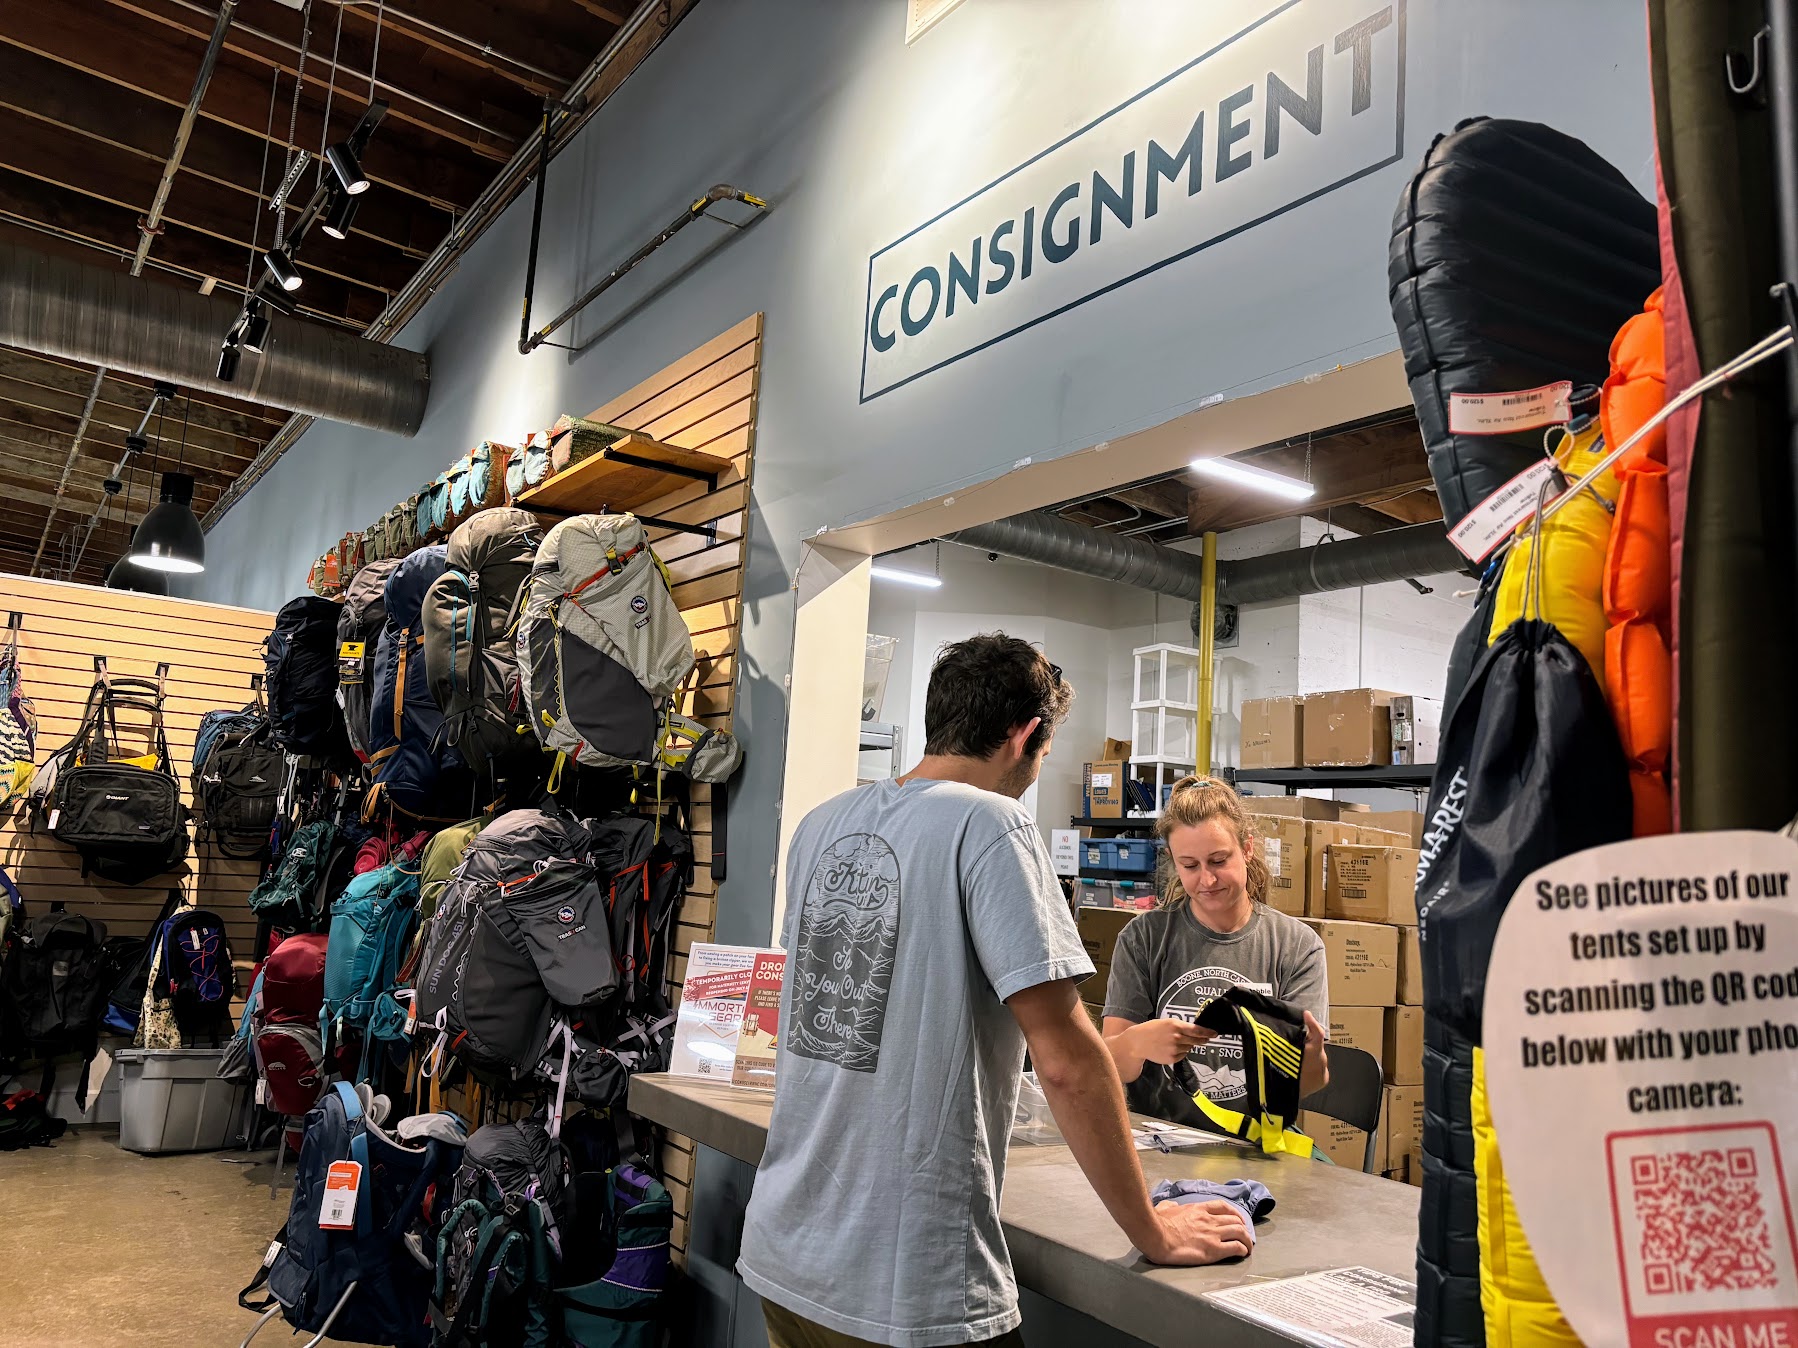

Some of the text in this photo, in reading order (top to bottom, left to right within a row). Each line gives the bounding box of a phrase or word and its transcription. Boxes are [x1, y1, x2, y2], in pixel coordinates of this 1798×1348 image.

[870, 4, 1393, 353] CONSIGNMENT
[1457, 519, 1476, 538] $120.00
[1062, 835, 1068, 843] NO
[1536, 870, 1790, 911] See pictures of our
[452, 919, 465, 939] 45L
[558, 930, 576, 940] TRAS
[1570, 920, 1766, 960] tents set up by
[439, 940, 454, 966] DOG
[430, 969, 442, 994] SUN
[696, 974, 738, 986] TEMPORARILY
[804, 972, 868, 1002] You Out
[1176, 972, 1202, 988] BOONE,
[1203, 969, 1230, 978] NORTH
[1524, 980, 1654, 1016] scanning
[1662, 975, 1706, 1006] the
[1712, 972, 1746, 1003] QR
[708, 1012, 742, 1023] GEAR
[813, 1005, 854, 1040] There
[1522, 1034, 1608, 1068] below
[1614, 1028, 1674, 1062] with
[1680, 1027, 1739, 1061] your
[1210, 1085, 1246, 1099] MATTERS
[1628, 1080, 1743, 1113] camera:
[1654, 1322, 1792, 1348] SCAN ME
